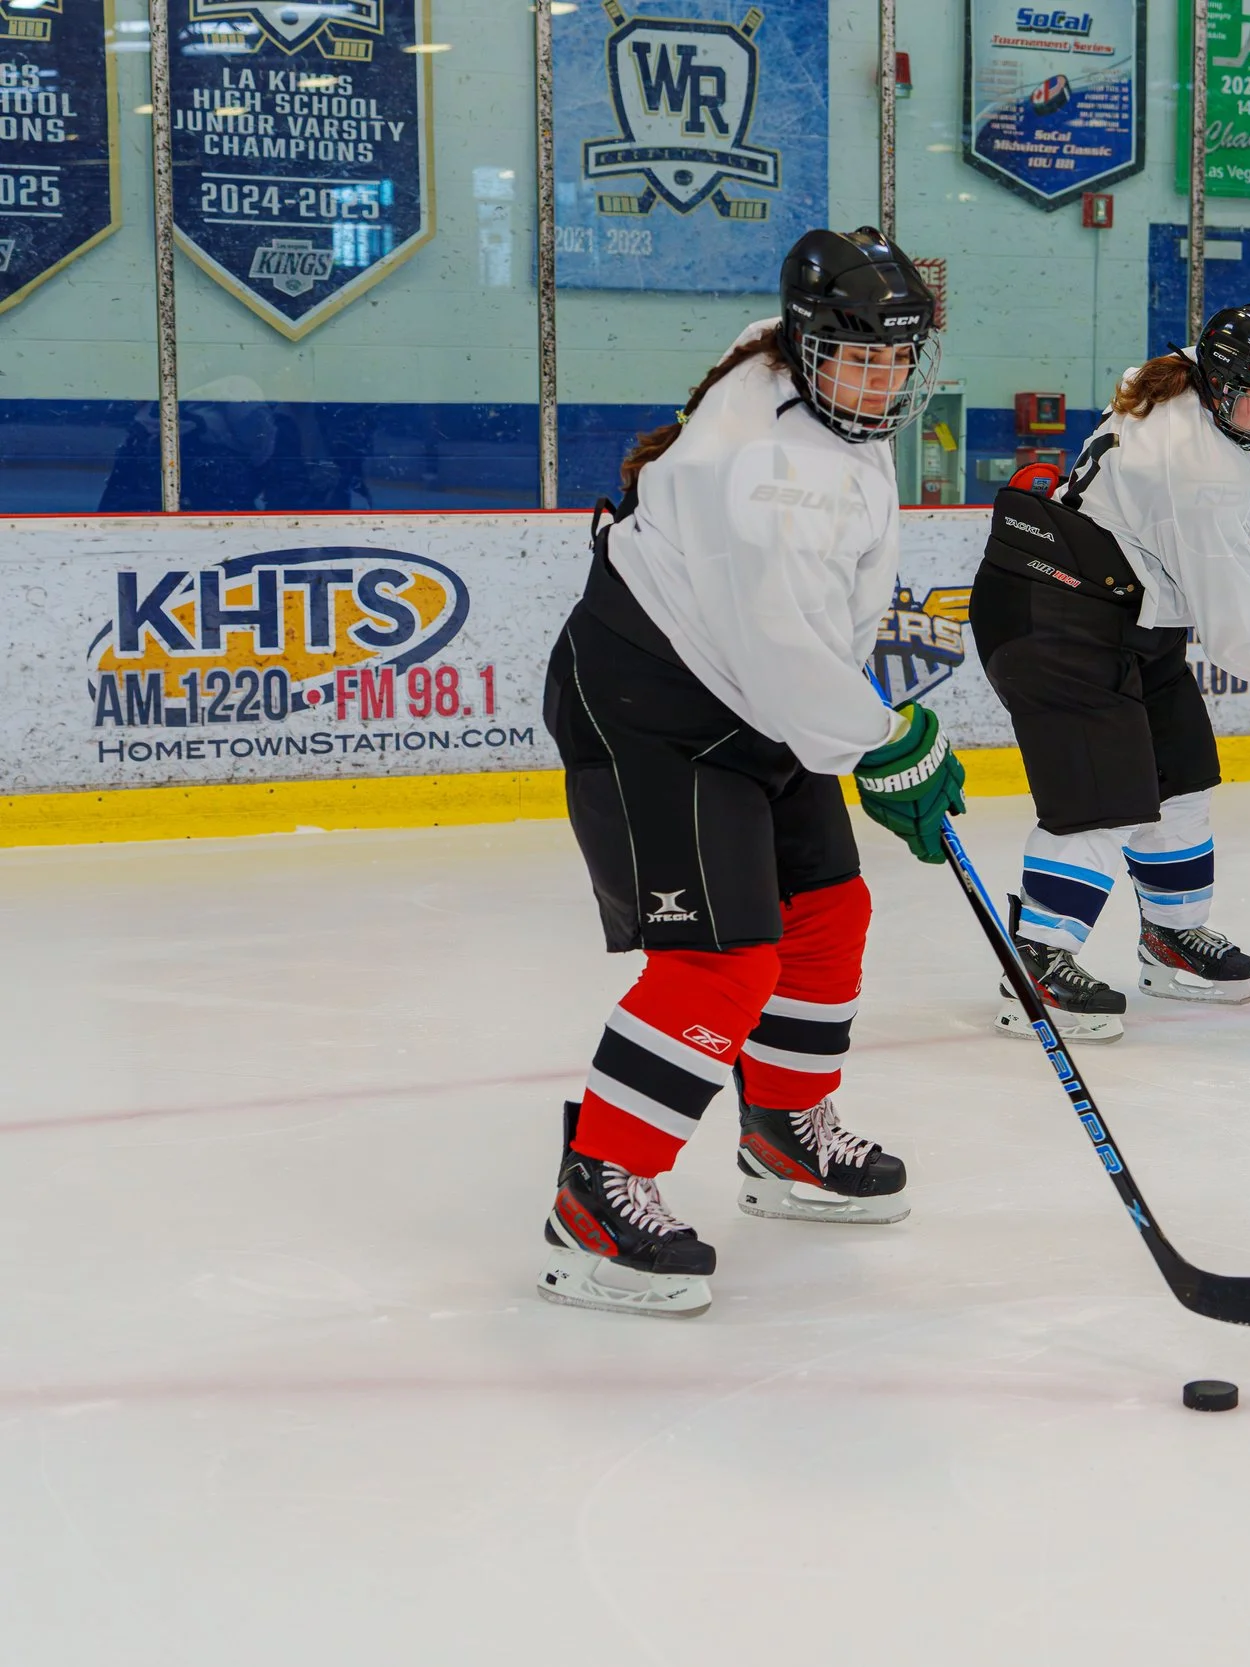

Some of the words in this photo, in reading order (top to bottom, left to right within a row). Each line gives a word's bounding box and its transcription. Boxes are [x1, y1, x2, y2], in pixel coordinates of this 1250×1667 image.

[1016, 8, 1092, 35] SoCal
[223, 67, 256, 90] LA
[269, 70, 353, 96] KINGS
[194, 88, 262, 112] HIGH
[275, 93, 383, 119] SCHOOL
[173, 109, 275, 135] JUNIOR
[287, 115, 405, 142] VARSITY
[204, 134, 374, 163] CHAMPIONS
[1205, 166, 1224, 180] as
[201, 182, 380, 219] 2024-2025
[253, 250, 331, 276] KINGS
[792, 303, 813, 318] CCM
[883, 315, 920, 327] CCM
[1213, 351, 1231, 363] CCM
[1004, 515, 1056, 542] TACKLA
[117, 568, 418, 653] KHTS
[95, 669, 162, 728] AM
[182, 667, 288, 725] 1220
[337, 668, 394, 721] FM
[408, 665, 496, 718] 98.1
[1031, 1018, 1124, 1175] BAUER
[562, 1196, 610, 1253] CCM
